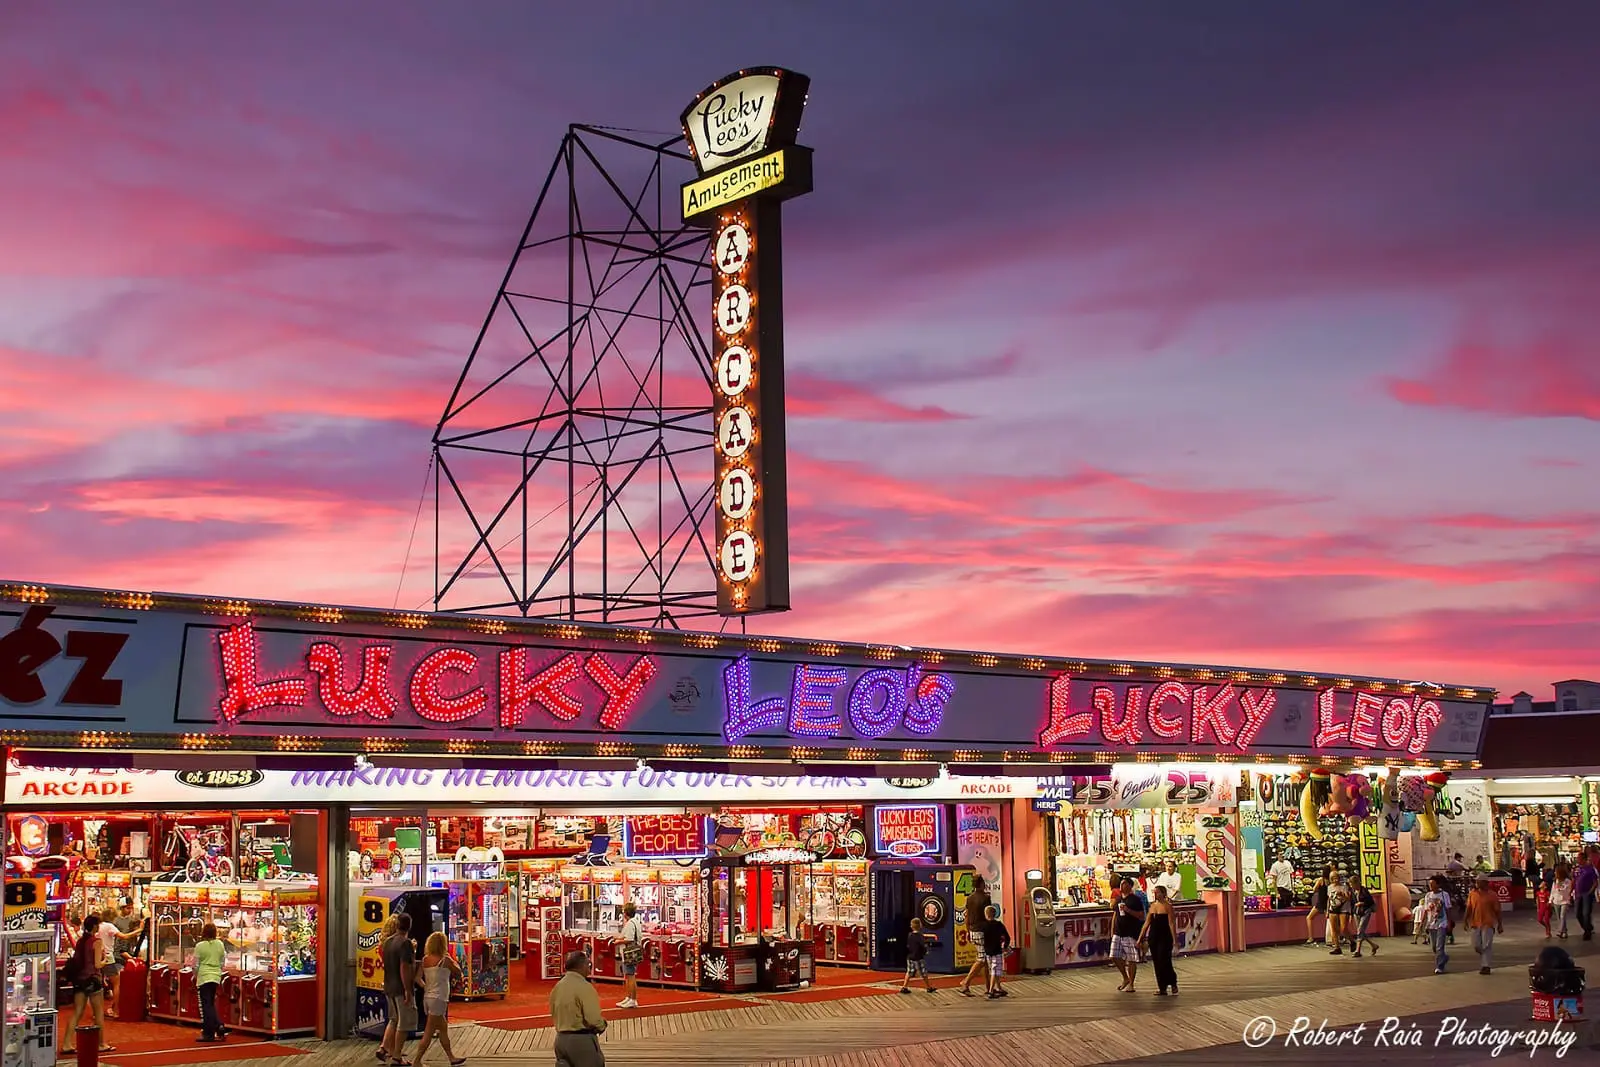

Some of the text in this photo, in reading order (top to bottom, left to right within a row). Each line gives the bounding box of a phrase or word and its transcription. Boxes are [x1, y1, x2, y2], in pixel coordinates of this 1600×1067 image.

[697, 91, 765, 152] Lucky
[687, 157, 781, 212] Amusement
[722, 231, 746, 573] ARCADE
[219, 621, 955, 744] LUCKY LEO'S
[1039, 672, 1277, 752] LUCKY
[1314, 688, 1443, 754] LEO'S
[206, 770, 253, 784] 1953
[291, 768, 432, 787] MAKING
[443, 768, 614, 787] MEMORIES
[622, 768, 676, 788] FOR
[686, 771, 753, 788] OVER
[1037, 776, 1066, 786] ATM
[22, 781, 135, 796] ARCADE
[961, 785, 1013, 795] ARCADE
[1039, 788, 1072, 799] MAC
[628, 816, 699, 833] THE BEST
[879, 809, 934, 825] LUCKY LEO'S
[960, 816, 999, 831] BEAR
[1202, 817, 1228, 828] 25¢
[634, 833, 699, 853] PEOPLE
[880, 825, 934, 841] AMUSEMENTS
[960, 832, 972, 845] THE
[1206, 831, 1225, 874] CANDY
[1362, 851, 1382, 890] WIN
[956, 873, 975, 896] 4
[1203, 877, 1229, 888] 25¢
[4, 882, 37, 906] 8
[363, 900, 384, 923] 8
[1023, 900, 1031, 949] ATM
